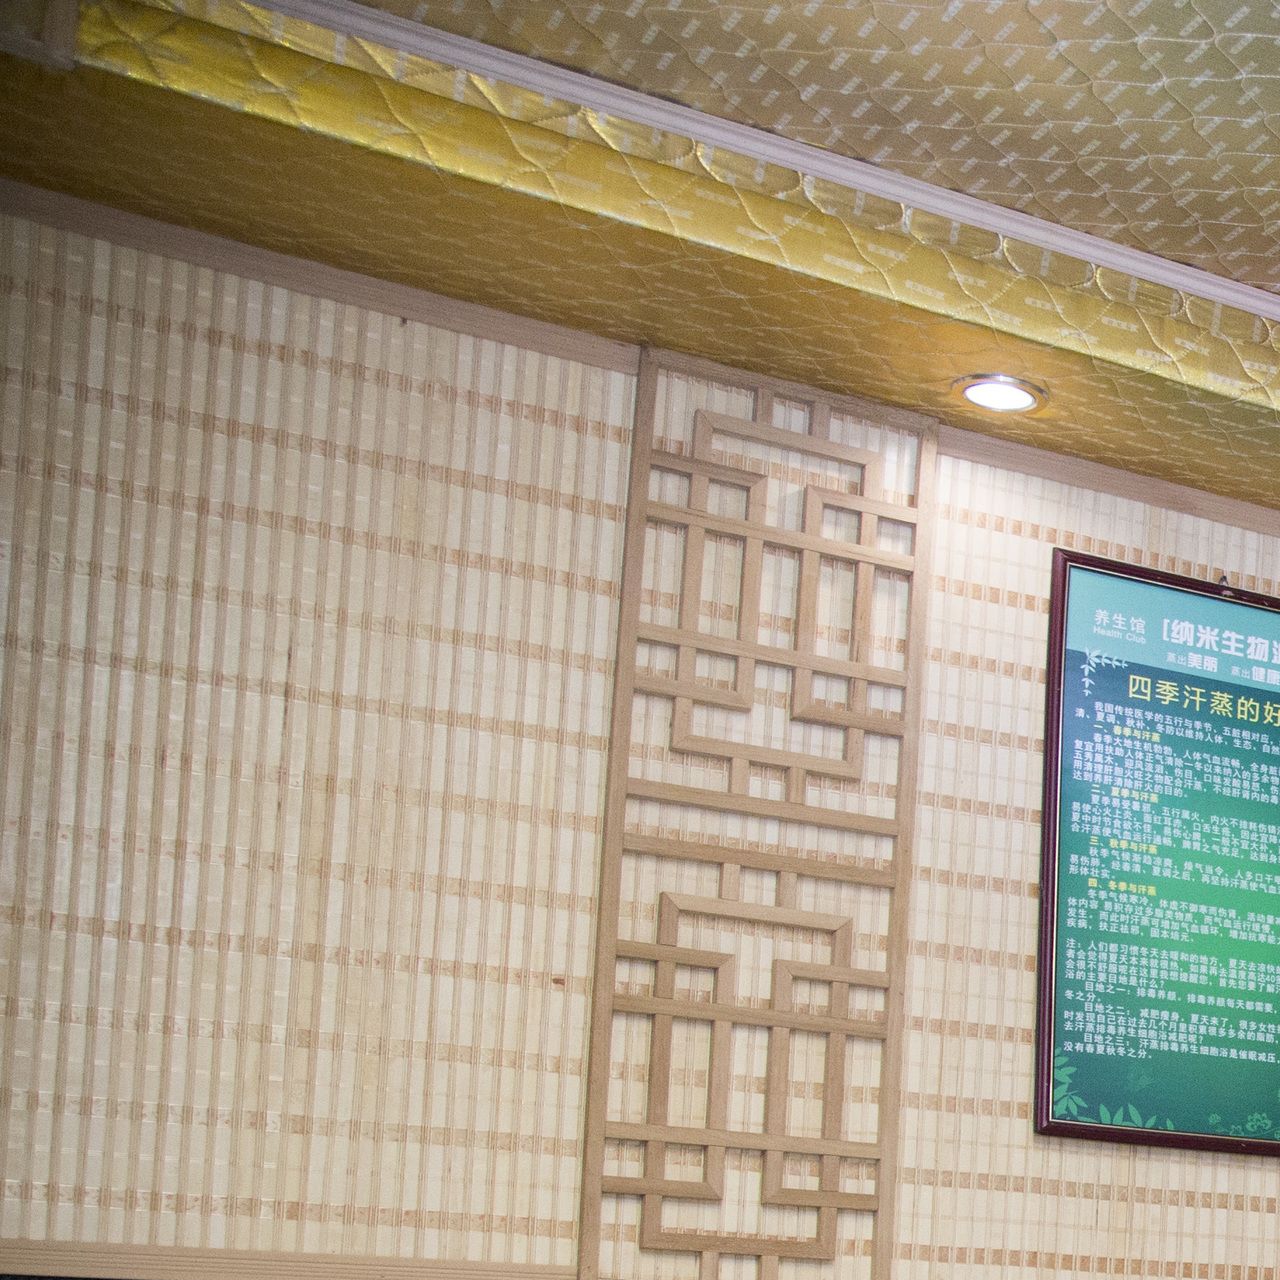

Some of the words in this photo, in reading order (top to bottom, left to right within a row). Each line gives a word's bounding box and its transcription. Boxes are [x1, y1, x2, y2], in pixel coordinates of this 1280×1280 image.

[1092, 624, 1124, 640] Health
[1125, 632, 1146, 644] Club
[1094, 609, 1146, 635] 养生馆
[1166, 647, 1218, 673] 蒸出美丽
[1230, 661, 1280, 686] 蒸出健康
